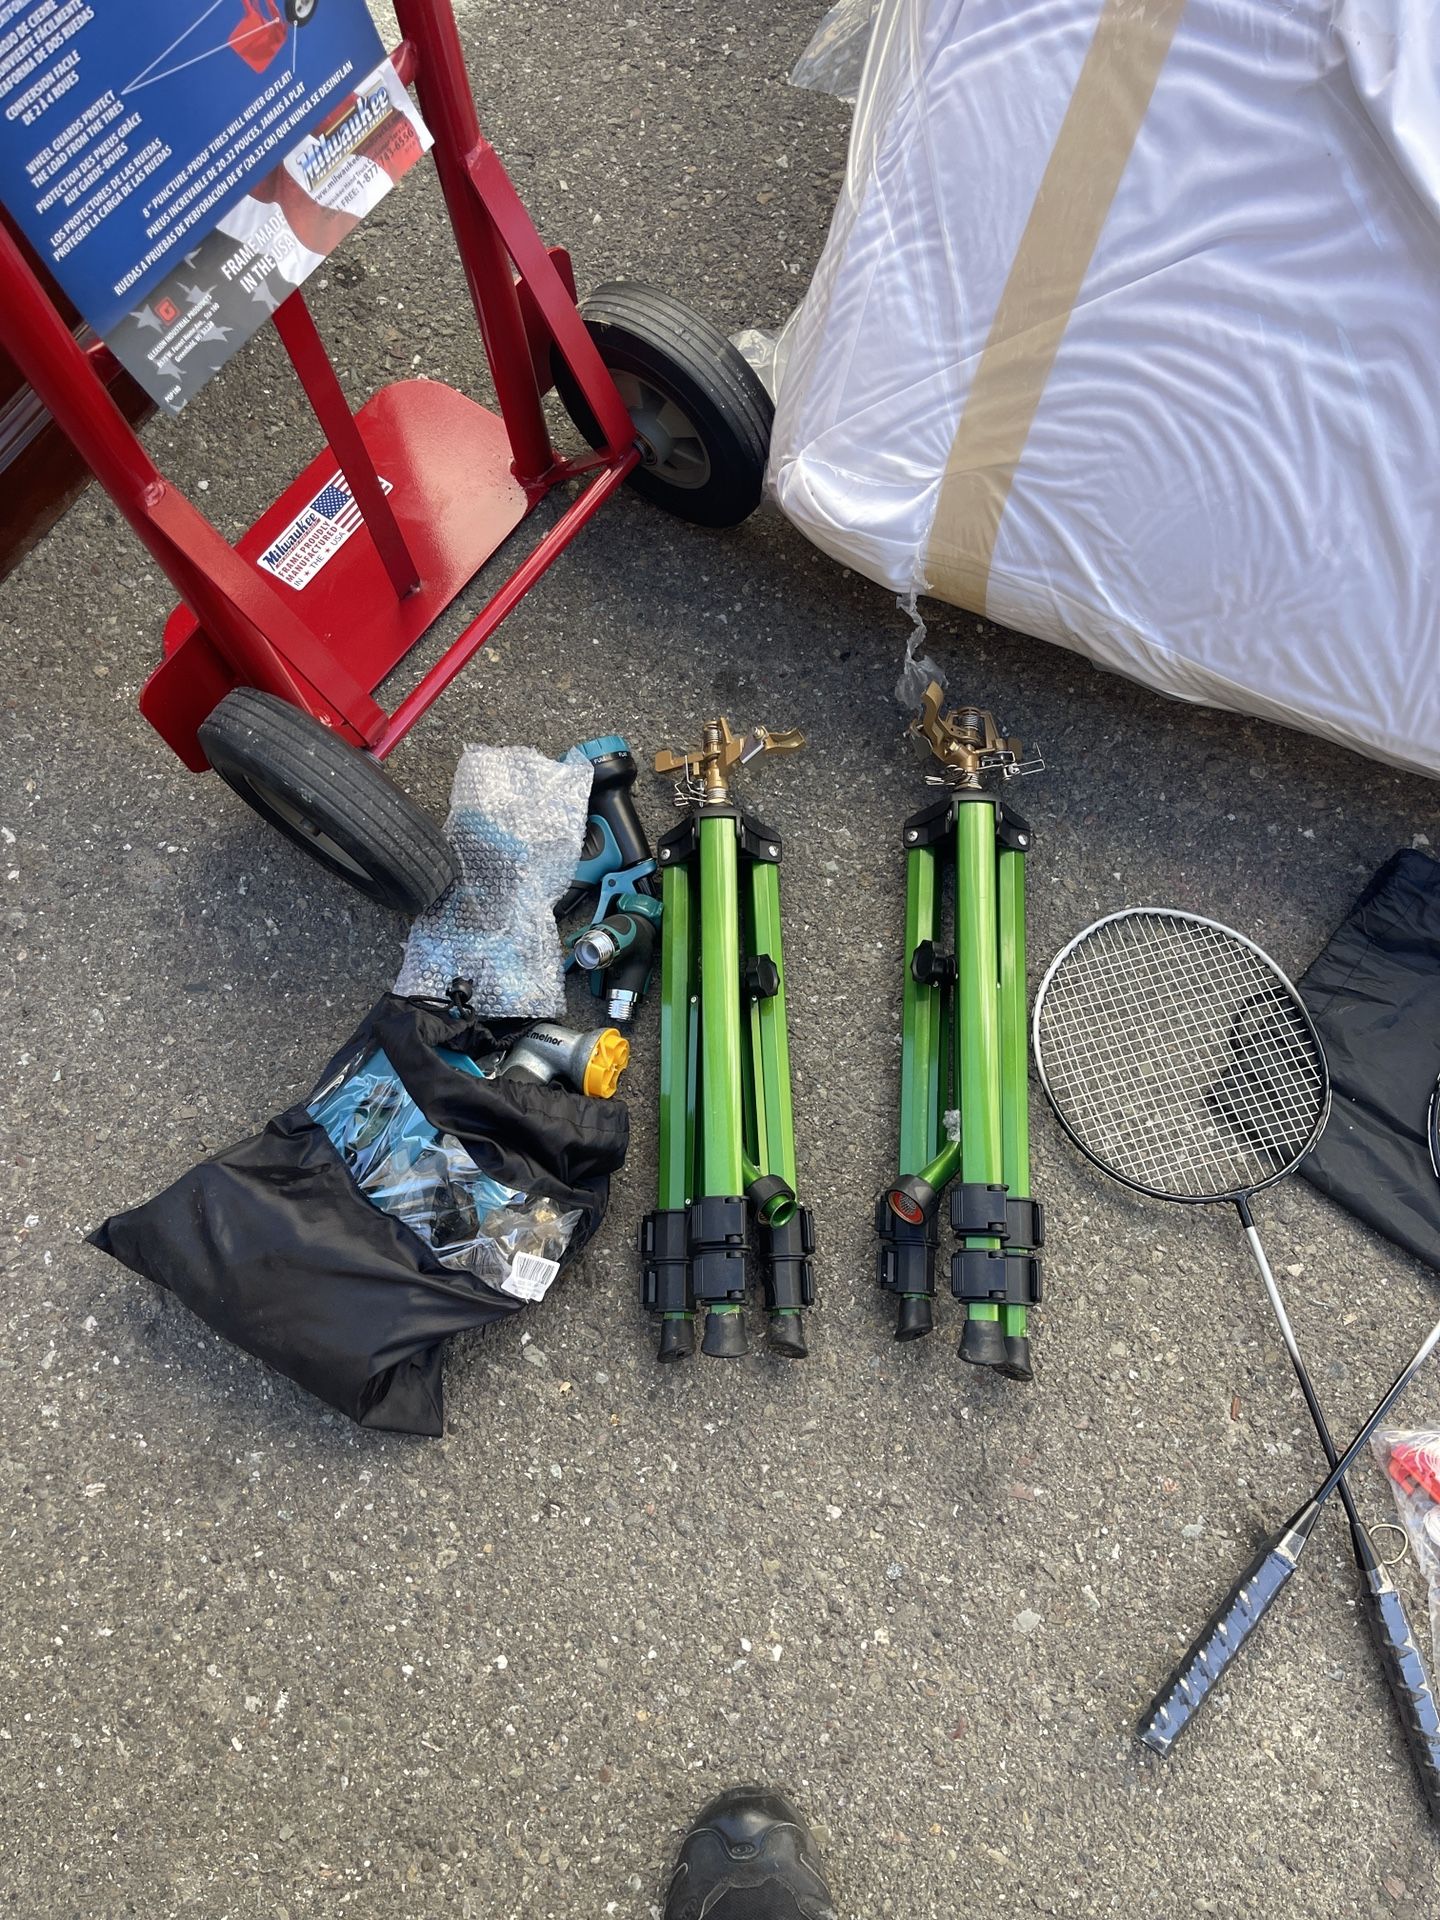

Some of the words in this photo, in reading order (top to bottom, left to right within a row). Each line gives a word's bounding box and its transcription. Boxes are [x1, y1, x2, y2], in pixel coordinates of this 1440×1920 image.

[34, 46, 48, 63] DE
[45, 32, 64, 54] DOS
[61, 5, 95, 40] RUEDAS
[5, 71, 55, 122] CONVERSION
[53, 49, 81, 79] FACILE
[22, 109, 36, 126] DE
[33, 103, 42, 116] 2
[44, 91, 55, 105] 4
[51, 69, 79, 99] ROUES
[26, 146, 53, 175] WHEEL
[52, 118, 84, 151] GUARDS
[82, 89, 116, 125] PROTECT
[31, 168, 49, 189] THE
[46, 151, 68, 175] LOAD
[66, 132, 89, 157] FROM
[87, 119, 103, 137] THE
[101, 99, 124, 124] TIRES
[146, 212, 170, 239] PNEUS
[168, 174, 209, 218] INCREVABLE
[206, 166, 218, 181] DE
[215, 148, 236, 172] 20.32
[233, 124, 261, 154] POUCES,
[259, 101, 285, 130] JAMAIS
[287, 81, 306, 102] PLAT
[152, 148, 211, 209] PUNCTURE-PROOF
[209, 131, 229, 153] TIRES
[227, 116, 245, 136] WILL
[242, 96, 265, 121] NEVER
[264, 86, 276, 101] GO
[273, 69, 293, 92] FLAT!
[295, 86, 389, 191] Milwaukee
[35, 167, 81, 214] PROTECTION
[79, 154, 95, 173] DES
[93, 133, 119, 161] PNEUS
[50, 228, 65, 247] LOS
[63, 184, 112, 234] PROTECTORES
[110, 174, 122, 190] DE
[120, 162, 135, 181] LAS
[133, 136, 162, 168] RUEDAS
[52, 220, 91, 262] PROTEGEN
[88, 213, 99, 227] LA
[98, 191, 122, 219] CARGA
[121, 181, 132, 197] DE
[130, 169, 145, 188] LAS
[143, 144, 172, 175] RUEDAS
[63, 186, 80, 206] AUX
[78, 141, 128, 192] GARDE-BOUES
[114, 265, 142, 296] RUEDAS
[139, 260, 147, 271] A
[145, 231, 177, 266] PRUEBAS
[174, 222, 186, 237] DE
[184, 181, 229, 228] PERFORACIÓN
[226, 172, 238, 187] DE
[263, 133, 278, 151] CM)
[276, 120, 291, 139] QUE
[288, 99, 313, 127] NUNCA
[309, 92, 321, 106] SE
[318, 60, 354, 98] DESINFLAN
[340, 186, 359, 207] FREE:
[222, 236, 260, 281] FRAME
[255, 209, 285, 246] MADE
[240, 270, 258, 294] IN
[252, 253, 275, 281] THE
[270, 231, 296, 263] USA
[147, 339, 167, 361] GLEASON
[164, 316, 190, 343] INDUSTRIAL
[262, 512, 316, 571] Milwaukee
[277, 551, 302, 577] FRAME
[299, 521, 330, 553] PROUDLY
[285, 526, 338, 582] MANUFACTURED
[293, 577, 303, 586] IN
[309, 554, 324, 569] THE
[330, 530, 345, 546] USA
[530, 1031, 563, 1047] melnor
